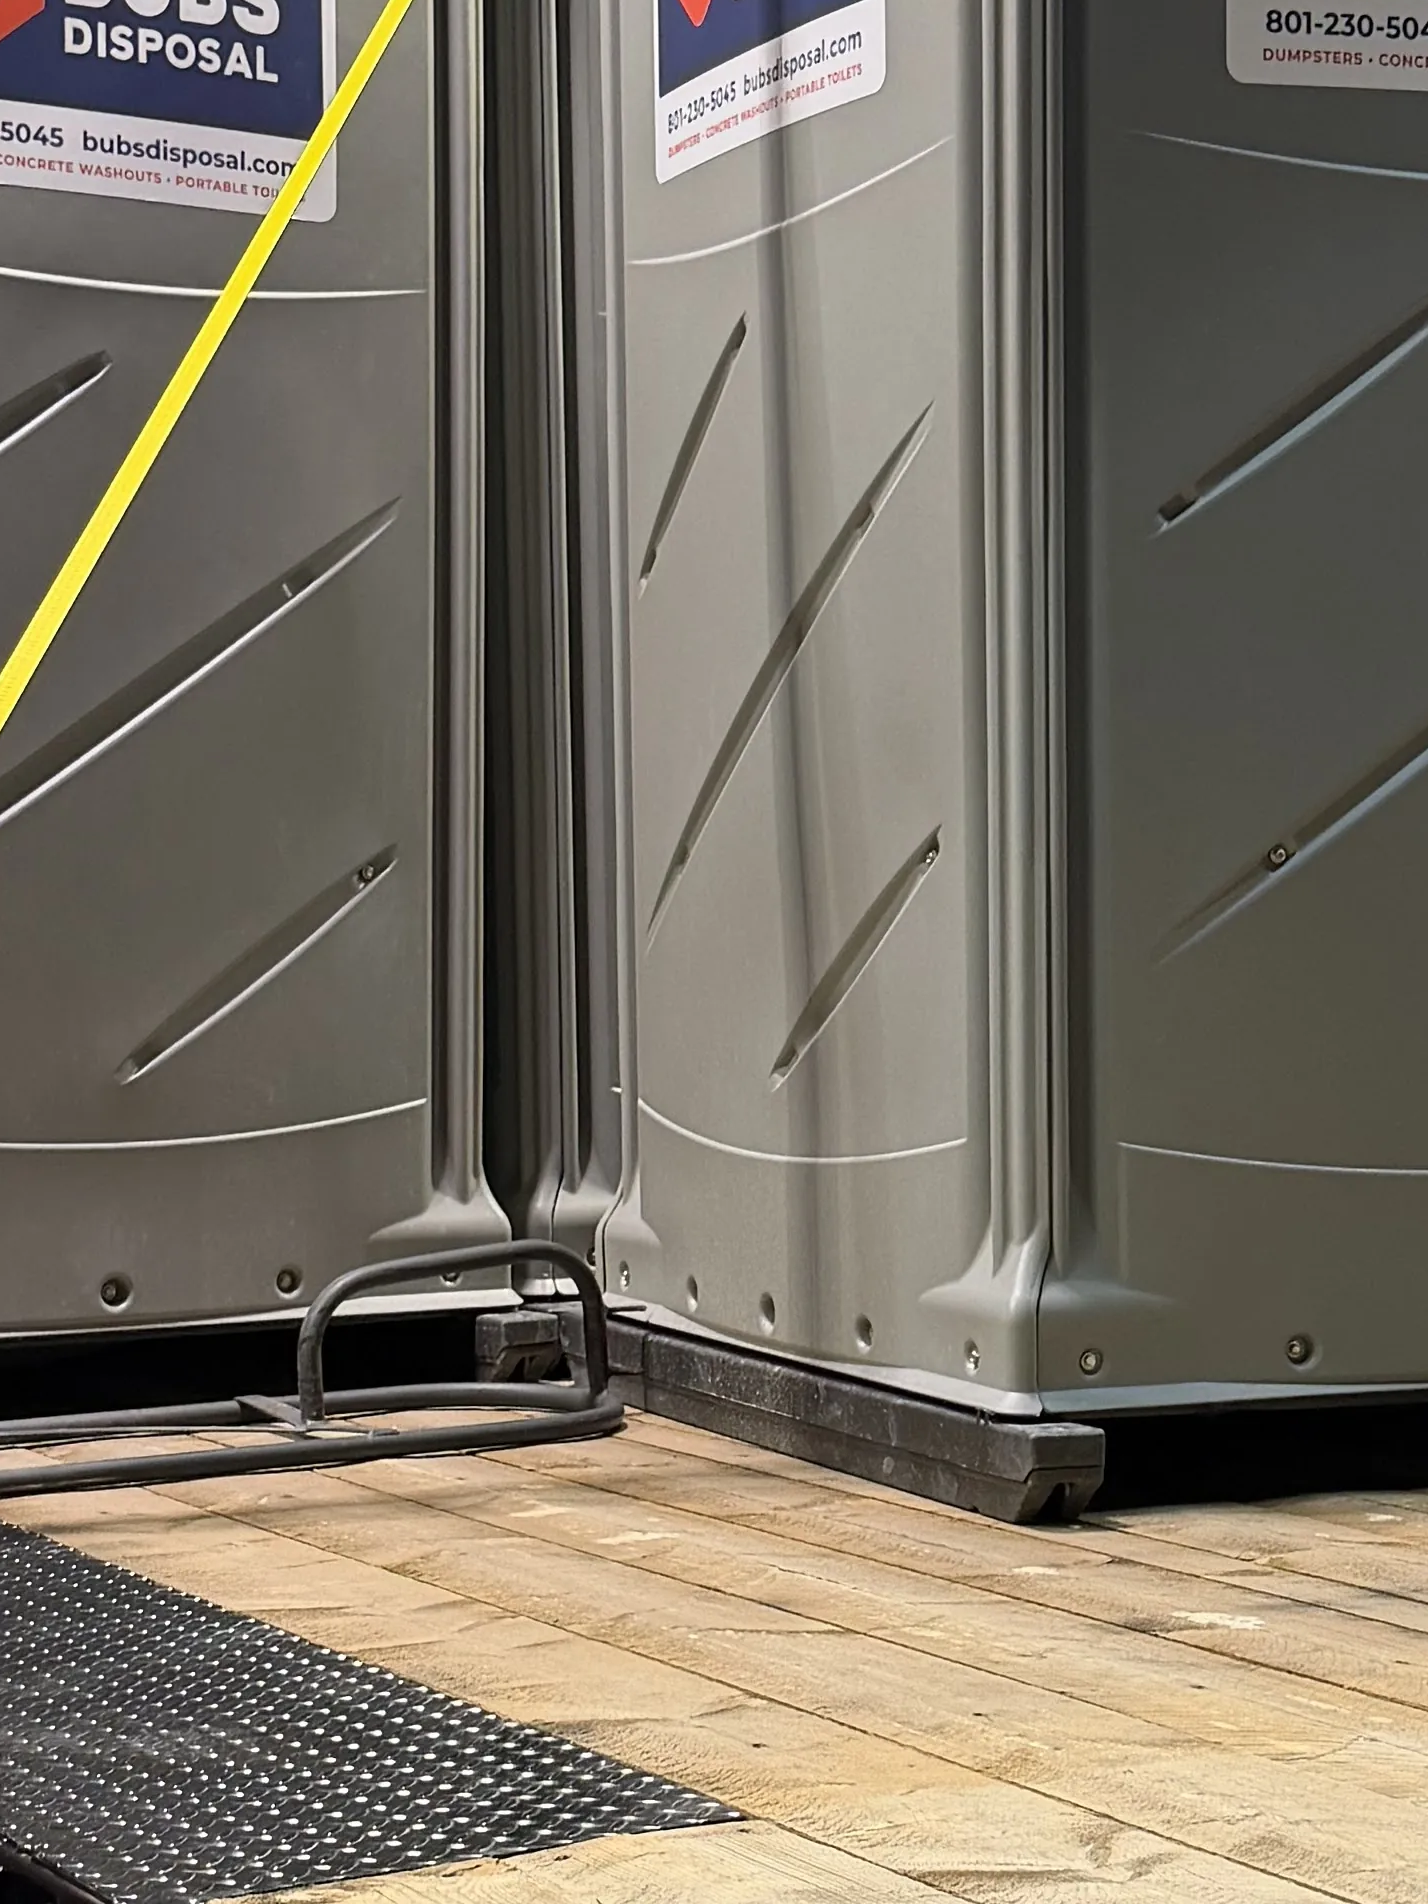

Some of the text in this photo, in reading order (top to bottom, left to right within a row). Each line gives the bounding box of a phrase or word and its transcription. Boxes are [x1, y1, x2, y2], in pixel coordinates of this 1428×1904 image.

[64, 16, 279, 83] DISPOSAL
[1262, 48, 1363, 66] DUMPSTERS
[668, 29, 862, 134] 801-230-5045 bubsdisposal.com
[827, 63, 862, 89] TOILETS
[79, 162, 162, 184] WASHOUTS
[176, 175, 248, 196] PORTABLE
